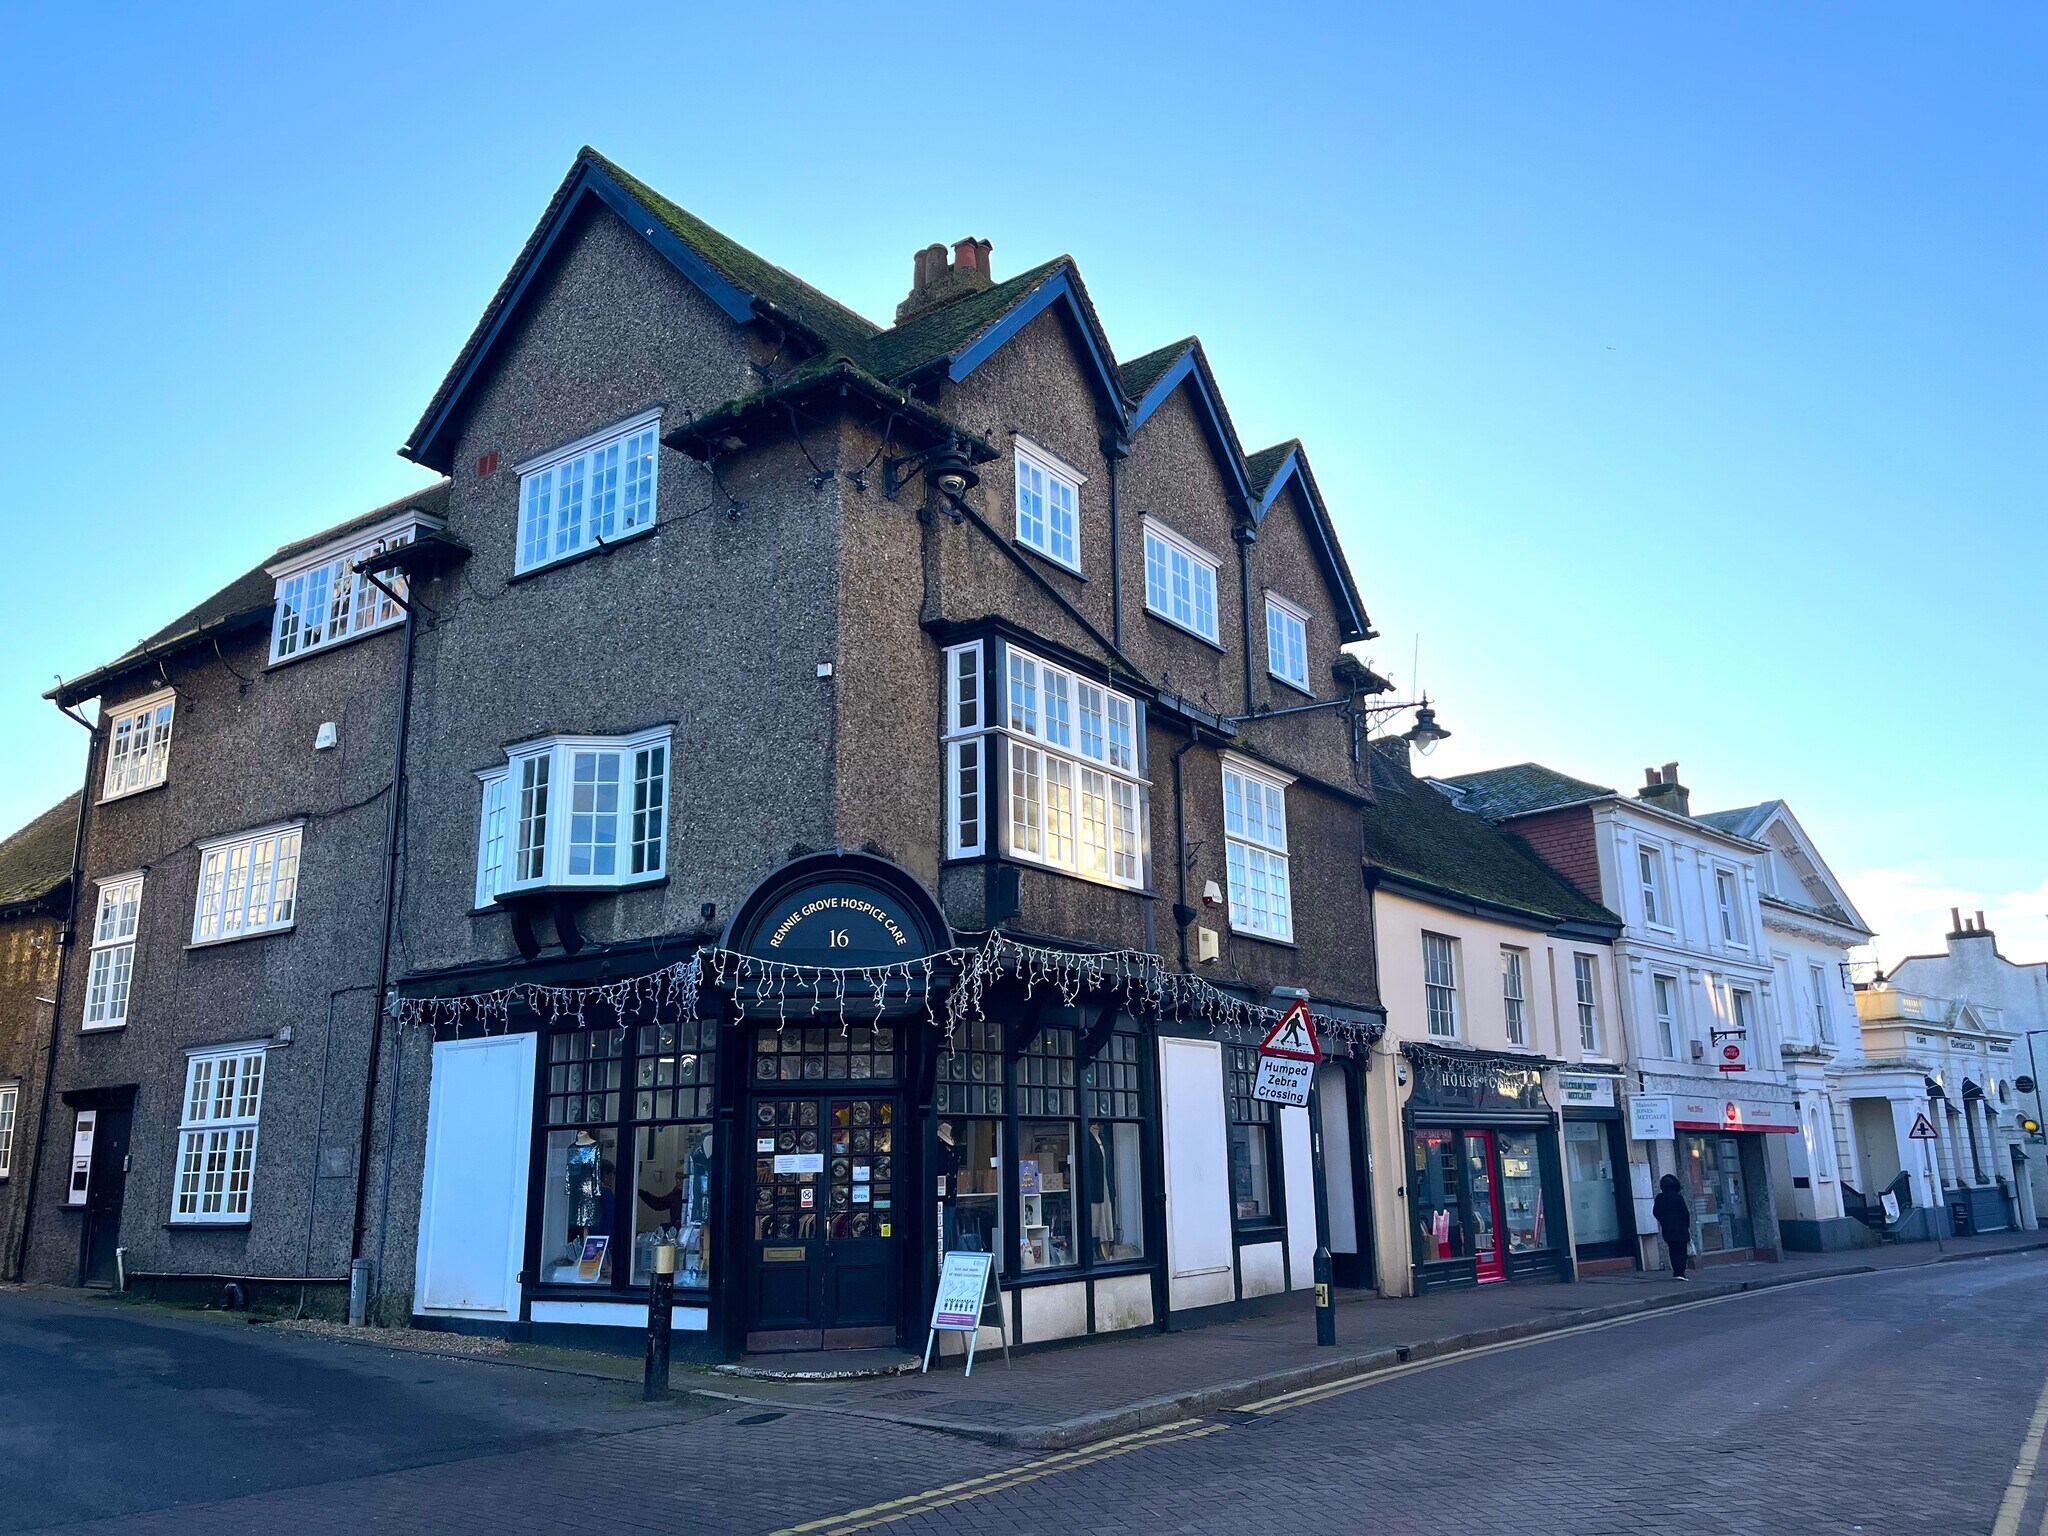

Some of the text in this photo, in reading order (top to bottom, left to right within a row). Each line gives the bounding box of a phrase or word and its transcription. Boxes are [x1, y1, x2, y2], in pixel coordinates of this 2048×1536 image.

[770, 897, 907, 948] RENNIE GROVE HOSPICE CARE
[828, 928, 849, 948] 16
[1264, 1062, 1308, 1076] Humped
[1268, 1074, 1298, 1088] Zebra
[1442, 1073, 1479, 1088] HOUSE
[1258, 1086, 1304, 1104] Crossing
